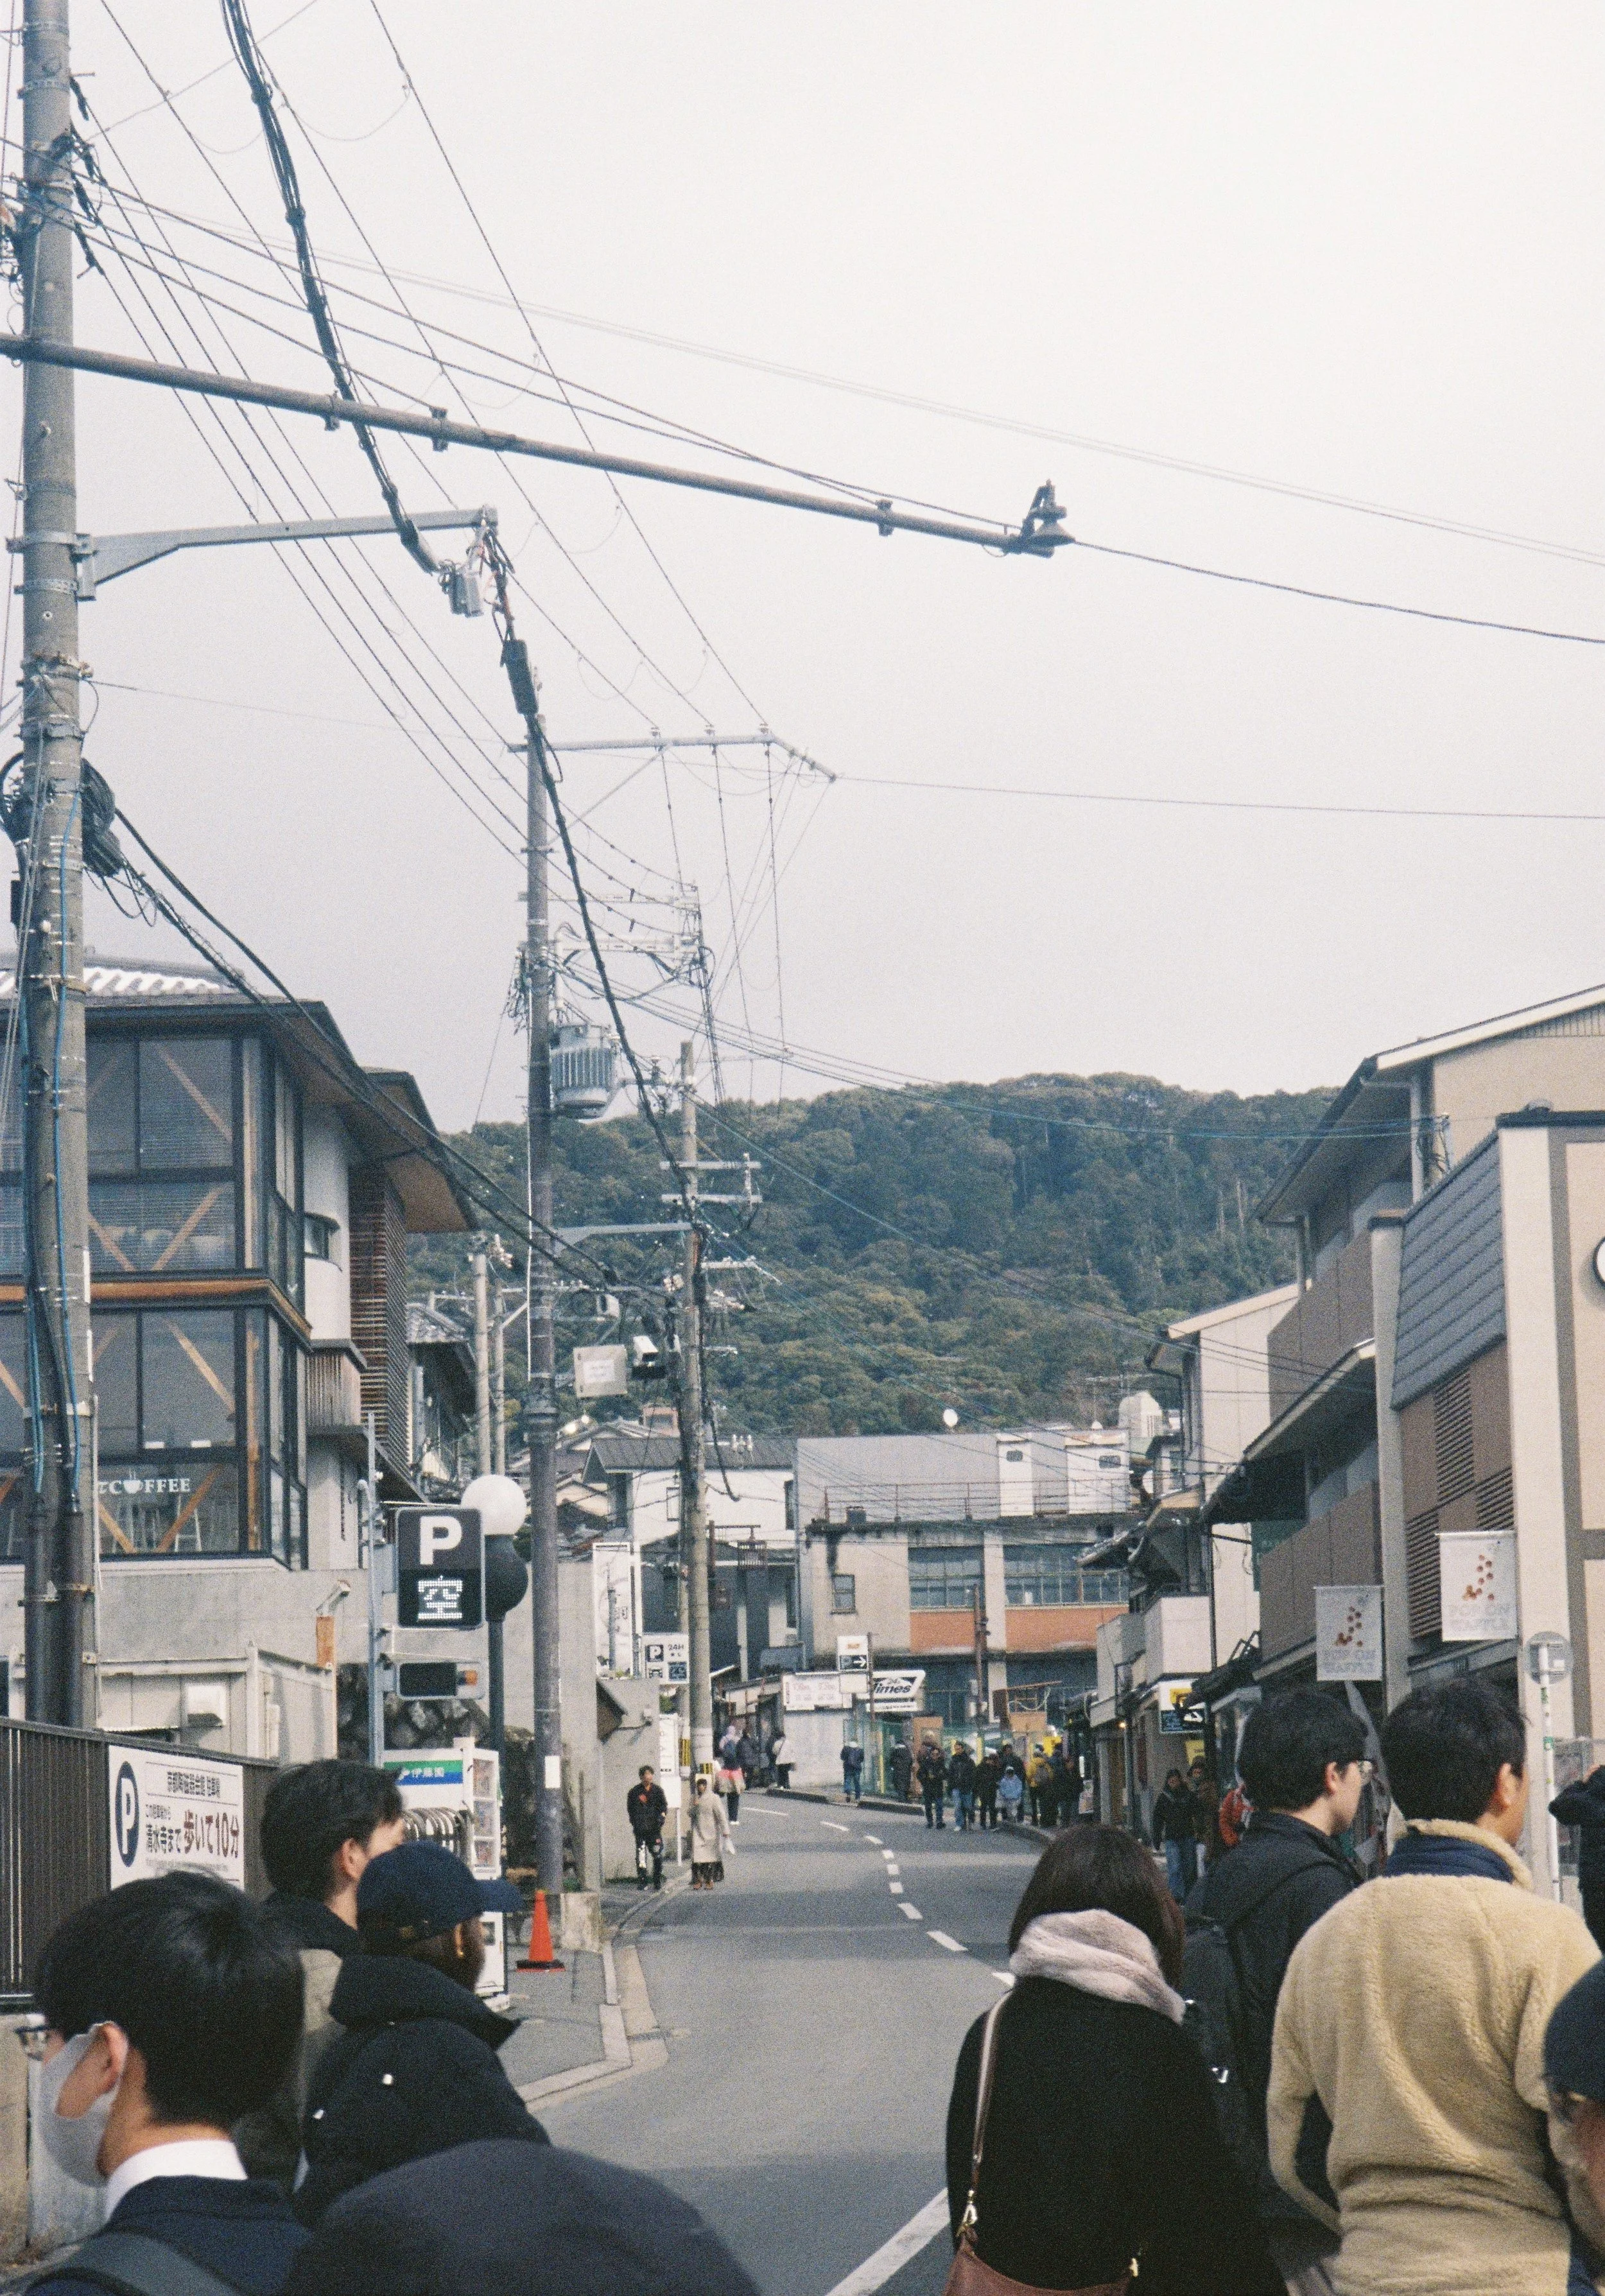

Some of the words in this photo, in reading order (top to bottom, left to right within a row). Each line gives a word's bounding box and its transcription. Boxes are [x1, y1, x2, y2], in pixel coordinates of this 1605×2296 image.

[421, 1516, 462, 1565] P
[418, 1575, 462, 1619] 空
[121, 1778, 135, 1854] P
